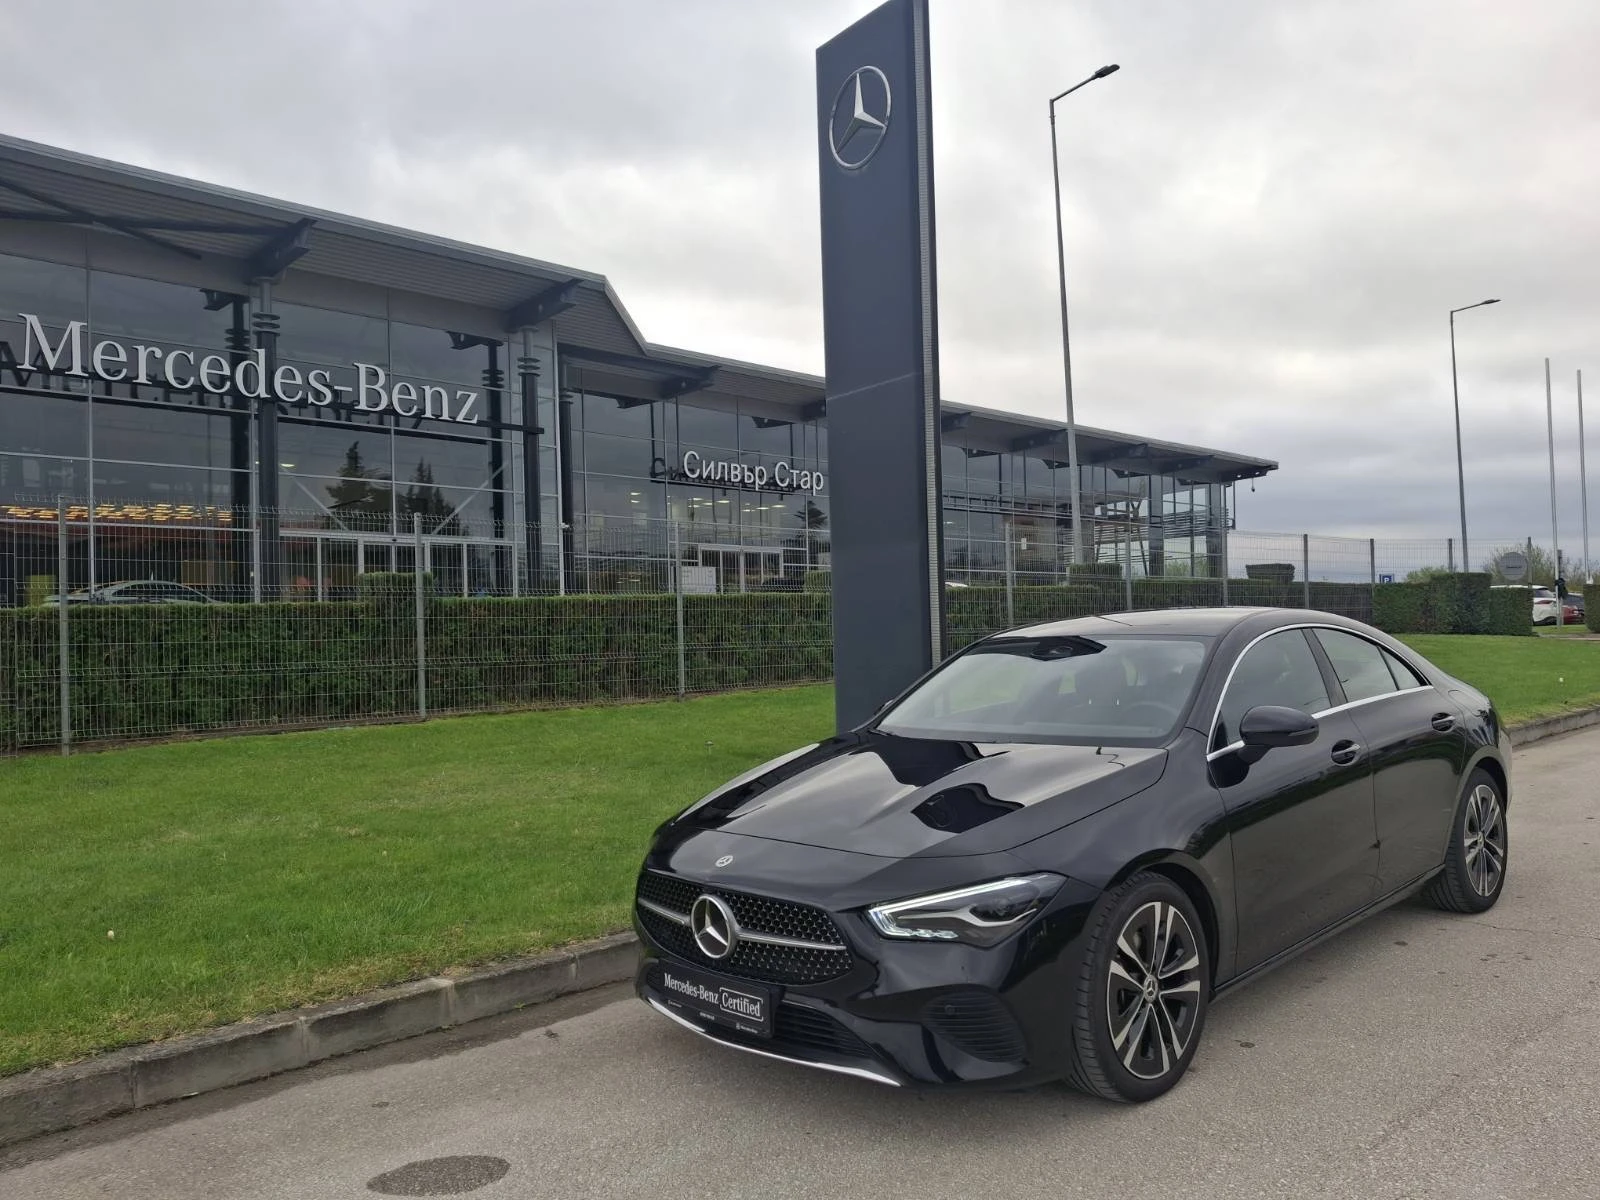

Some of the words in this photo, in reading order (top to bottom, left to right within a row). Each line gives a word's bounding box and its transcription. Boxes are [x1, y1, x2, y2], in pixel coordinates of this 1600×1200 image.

[16, 312, 479, 425] Mercedes-Benz
[683, 450, 767, 491] Силвър
[774, 461, 825, 496] Стар
[664, 972, 719, 1005] Mercedes-Benz
[721, 992, 761, 1017] Certified
